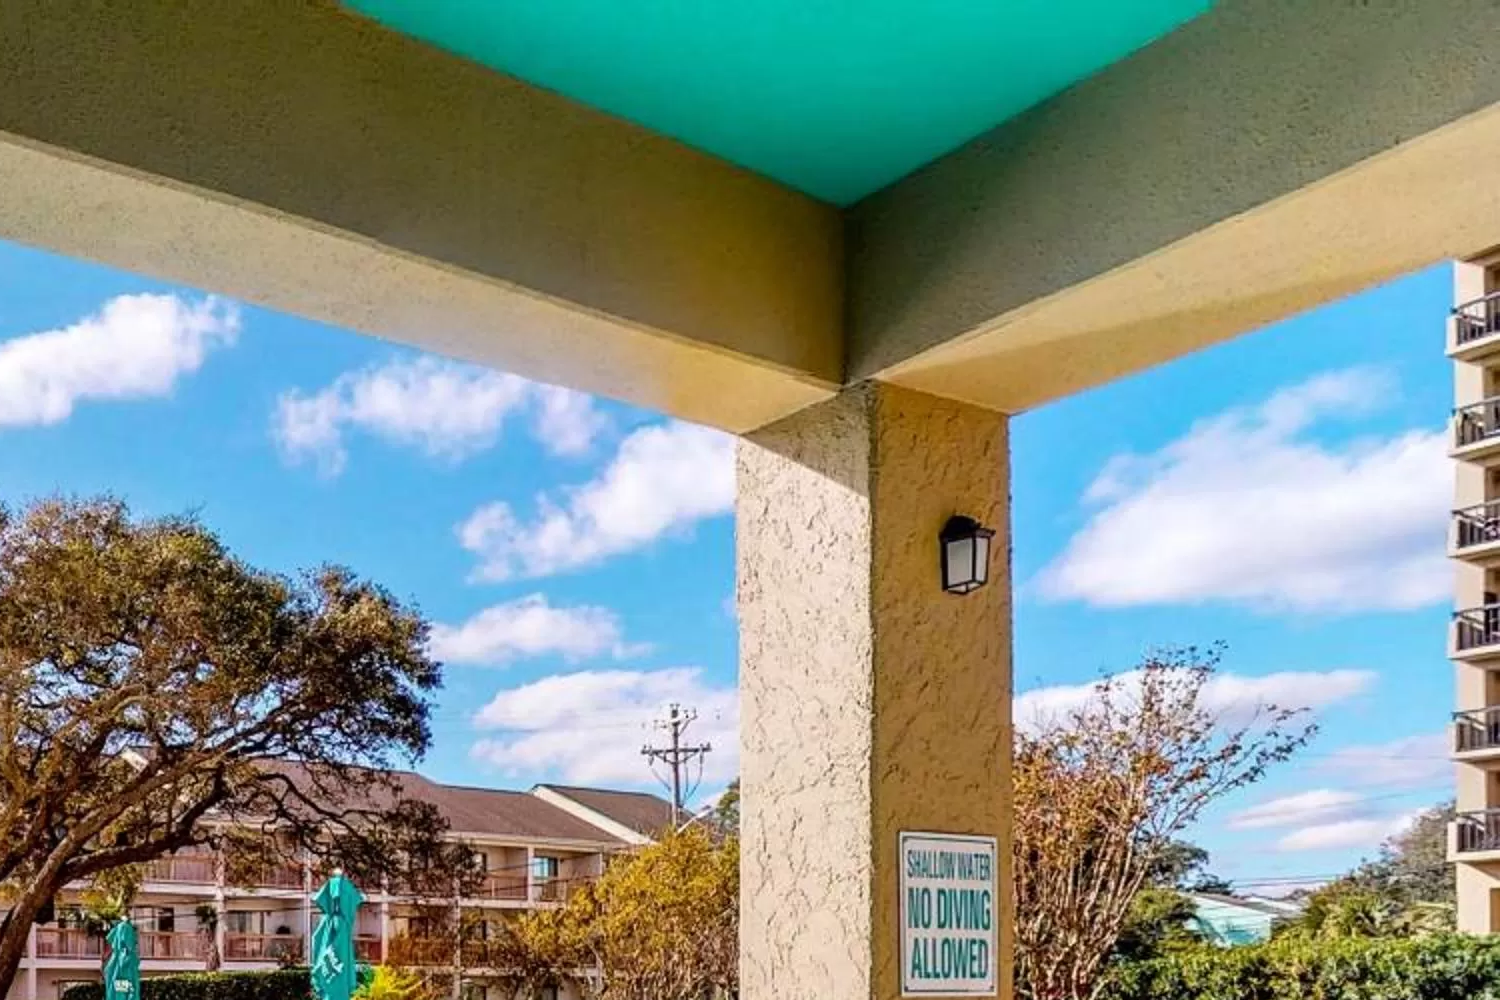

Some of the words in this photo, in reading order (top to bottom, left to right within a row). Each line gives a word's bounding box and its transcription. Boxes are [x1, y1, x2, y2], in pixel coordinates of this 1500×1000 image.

[907, 849, 955, 880] SHALLOW
[957, 852, 991, 881] WATER
[907, 887, 932, 929] NO
[937, 888, 991, 931] DIVING
[911, 936, 989, 979] ALLOWED
